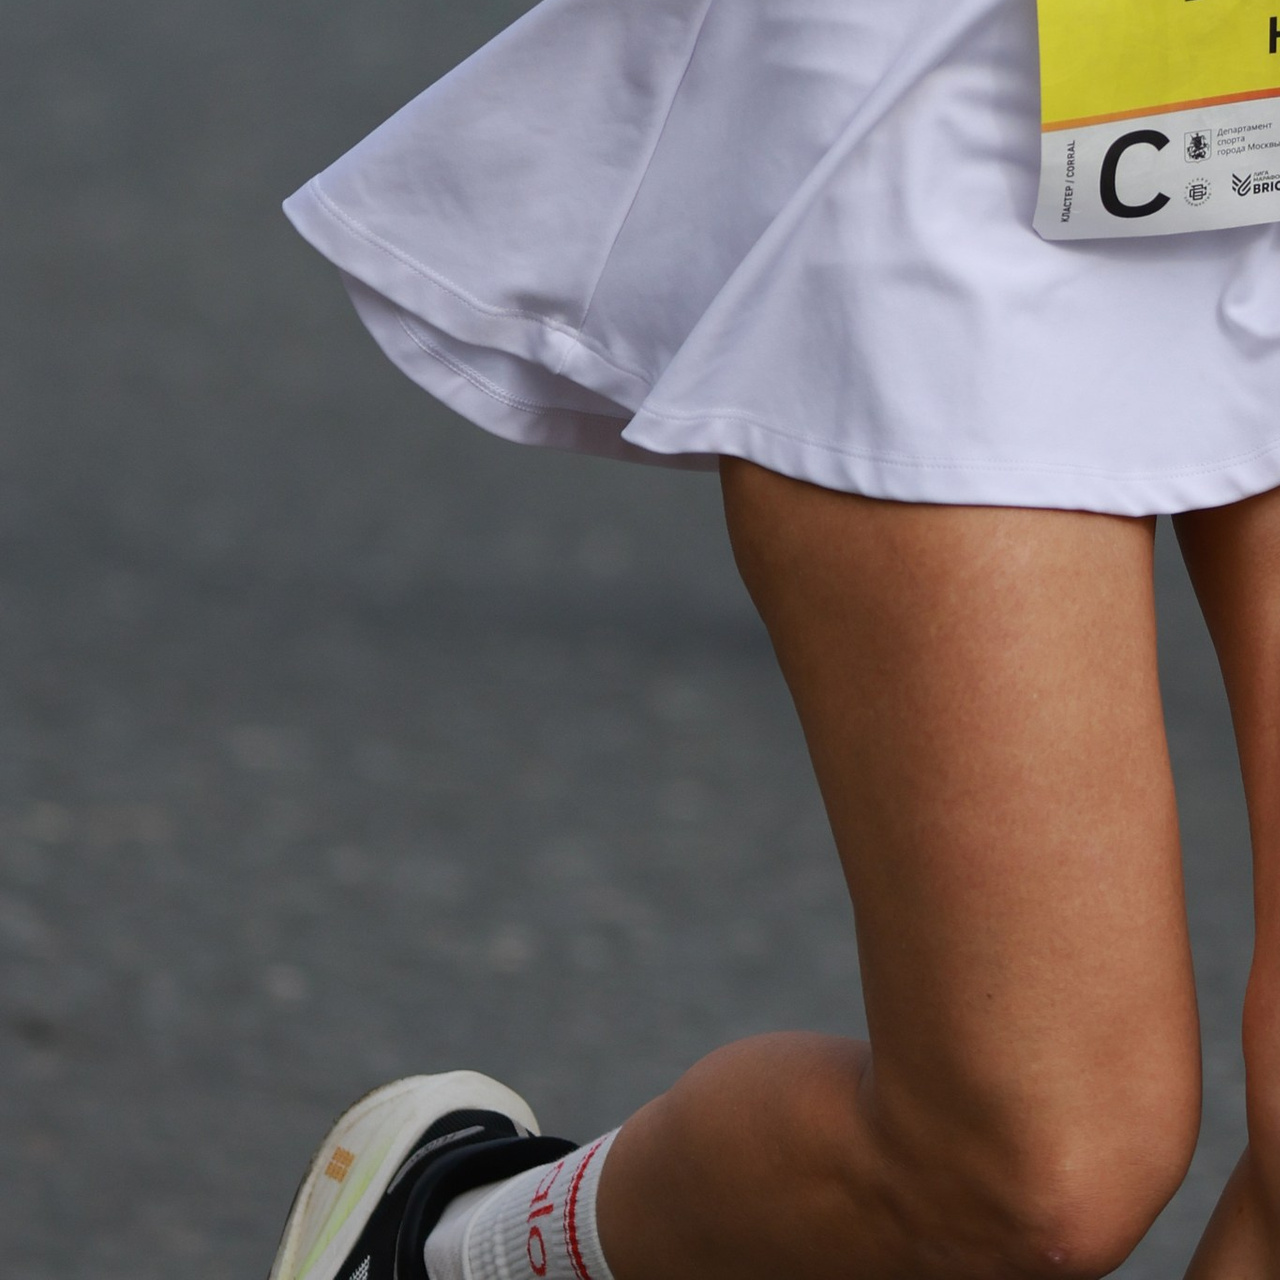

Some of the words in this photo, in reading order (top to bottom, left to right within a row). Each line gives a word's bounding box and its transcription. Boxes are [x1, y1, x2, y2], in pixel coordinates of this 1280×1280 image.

[1216, 122, 1273, 138] Департамент
[1216, 135, 1246, 147] спорта
[1216, 145, 1246, 157] города
[1248, 140, 1280, 152] Москвы
[1065, 140, 1076, 178] CORRAL
[1060, 185, 1075, 223] КЛАСТЕР
